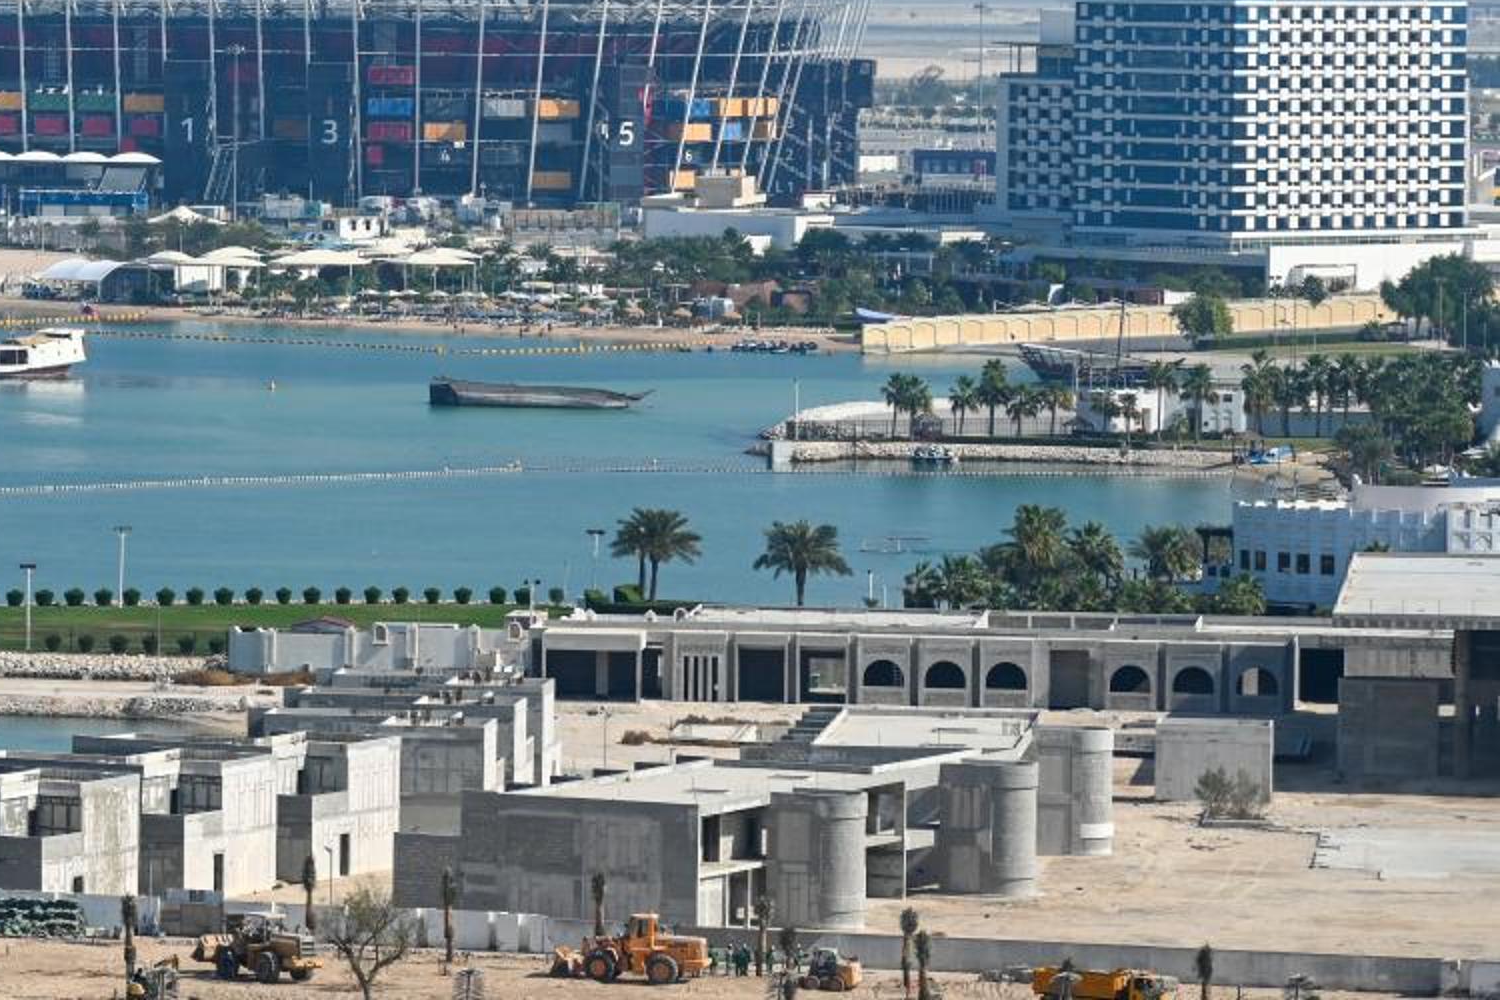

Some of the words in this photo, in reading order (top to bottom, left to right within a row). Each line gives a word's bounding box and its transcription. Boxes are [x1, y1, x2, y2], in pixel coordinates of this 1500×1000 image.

[181, 117, 194, 143] 1
[321, 120, 338, 144] 3
[619, 121, 634, 145] 5
[685, 150, 693, 162] 6
